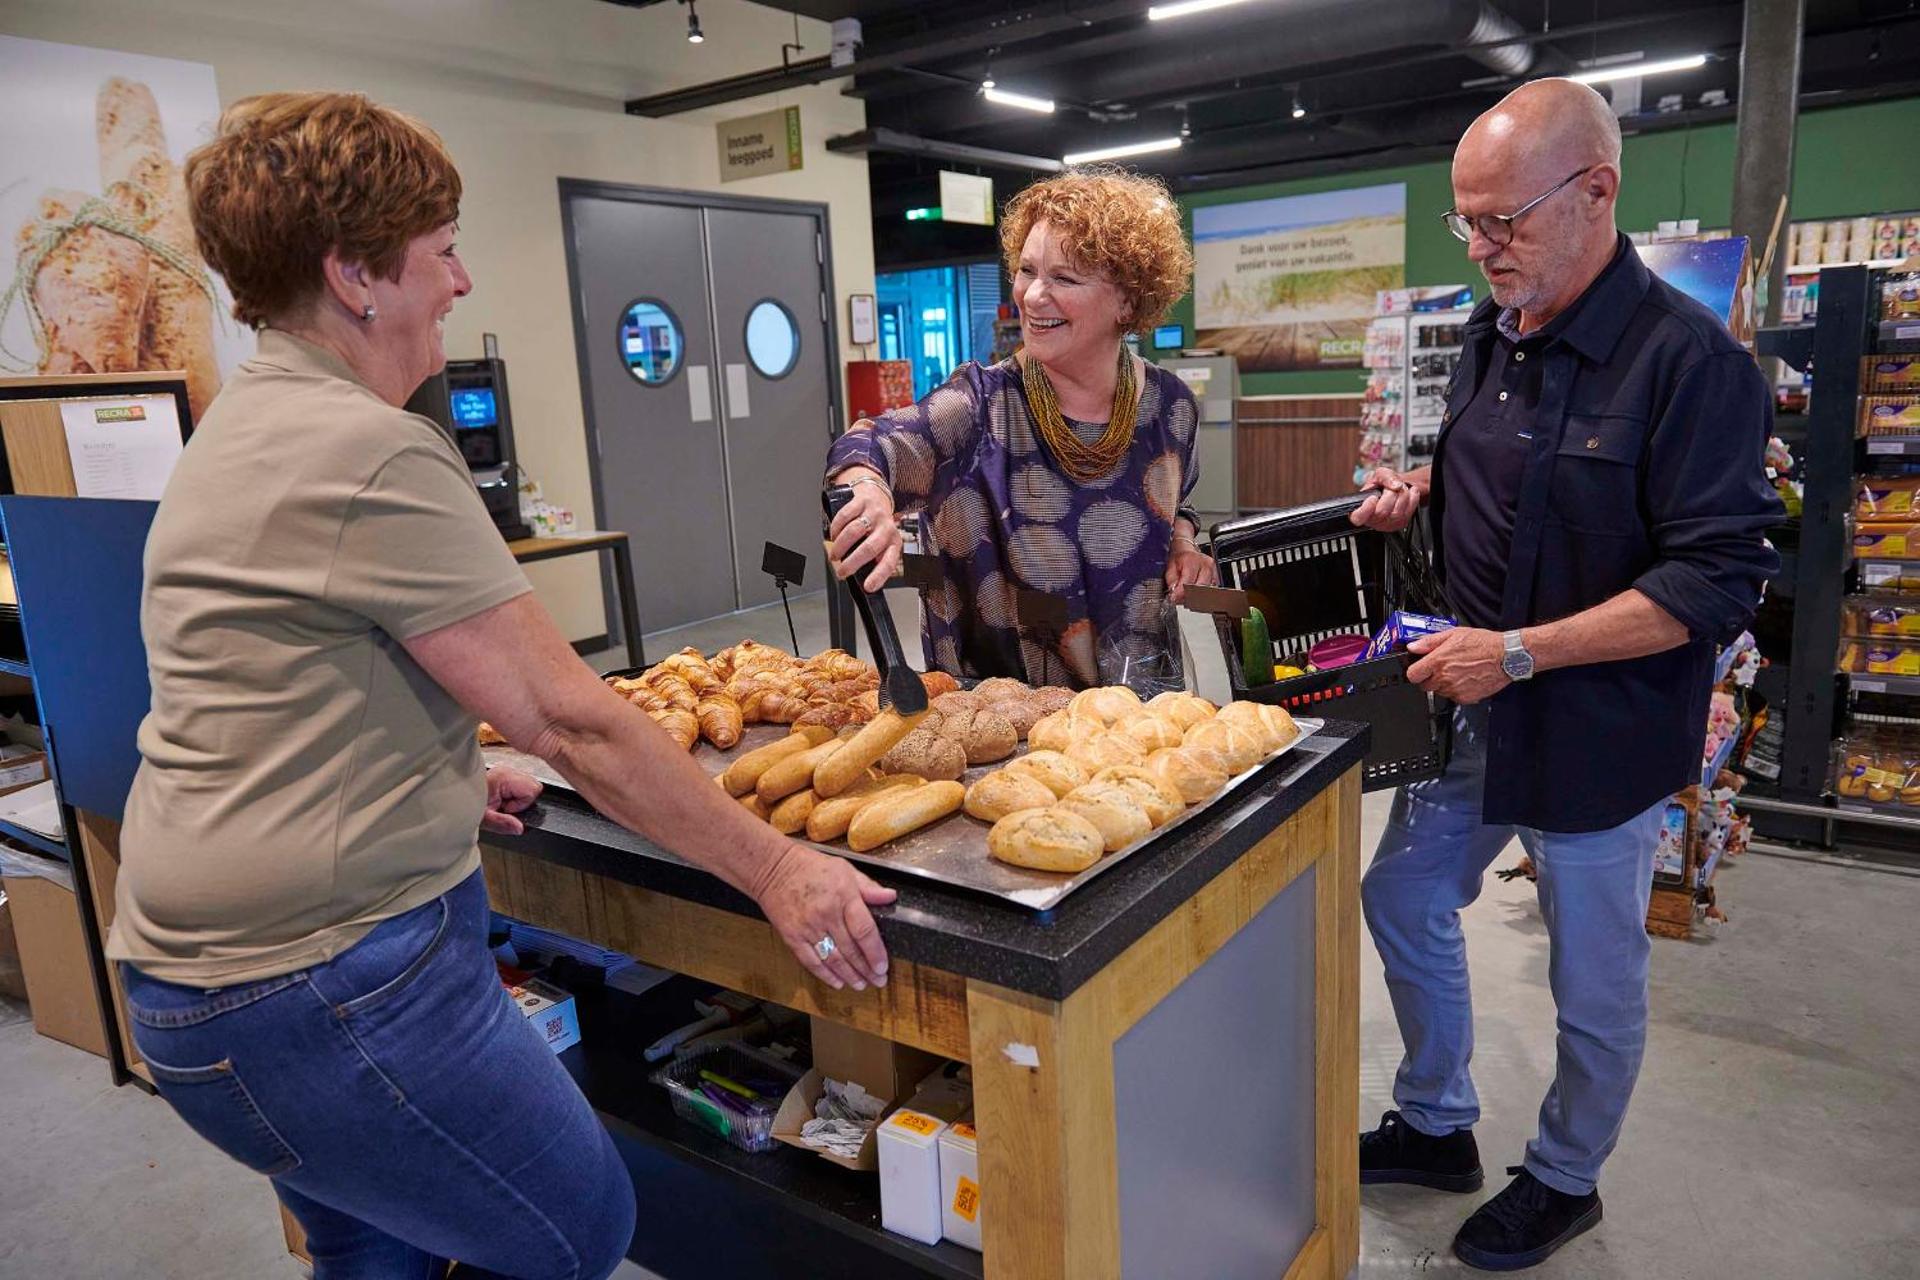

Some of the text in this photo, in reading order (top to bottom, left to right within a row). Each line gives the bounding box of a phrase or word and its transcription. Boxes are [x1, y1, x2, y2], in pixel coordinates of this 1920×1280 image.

[728, 144, 774, 167] leeggoed
[1240, 243, 1264, 256] Dank
[1269, 242, 1289, 252] voor
[1292, 241, 1306, 250] uw
[1235, 260, 1267, 273] geniet
[1270, 259, 1288, 267] van
[1291, 258, 1305, 266] uw
[1320, 339, 1366, 355] RECR
[96, 407, 131, 418] RECRA
[902, 1115, 928, 1128] 25%
[958, 1186, 971, 1209] 50%
